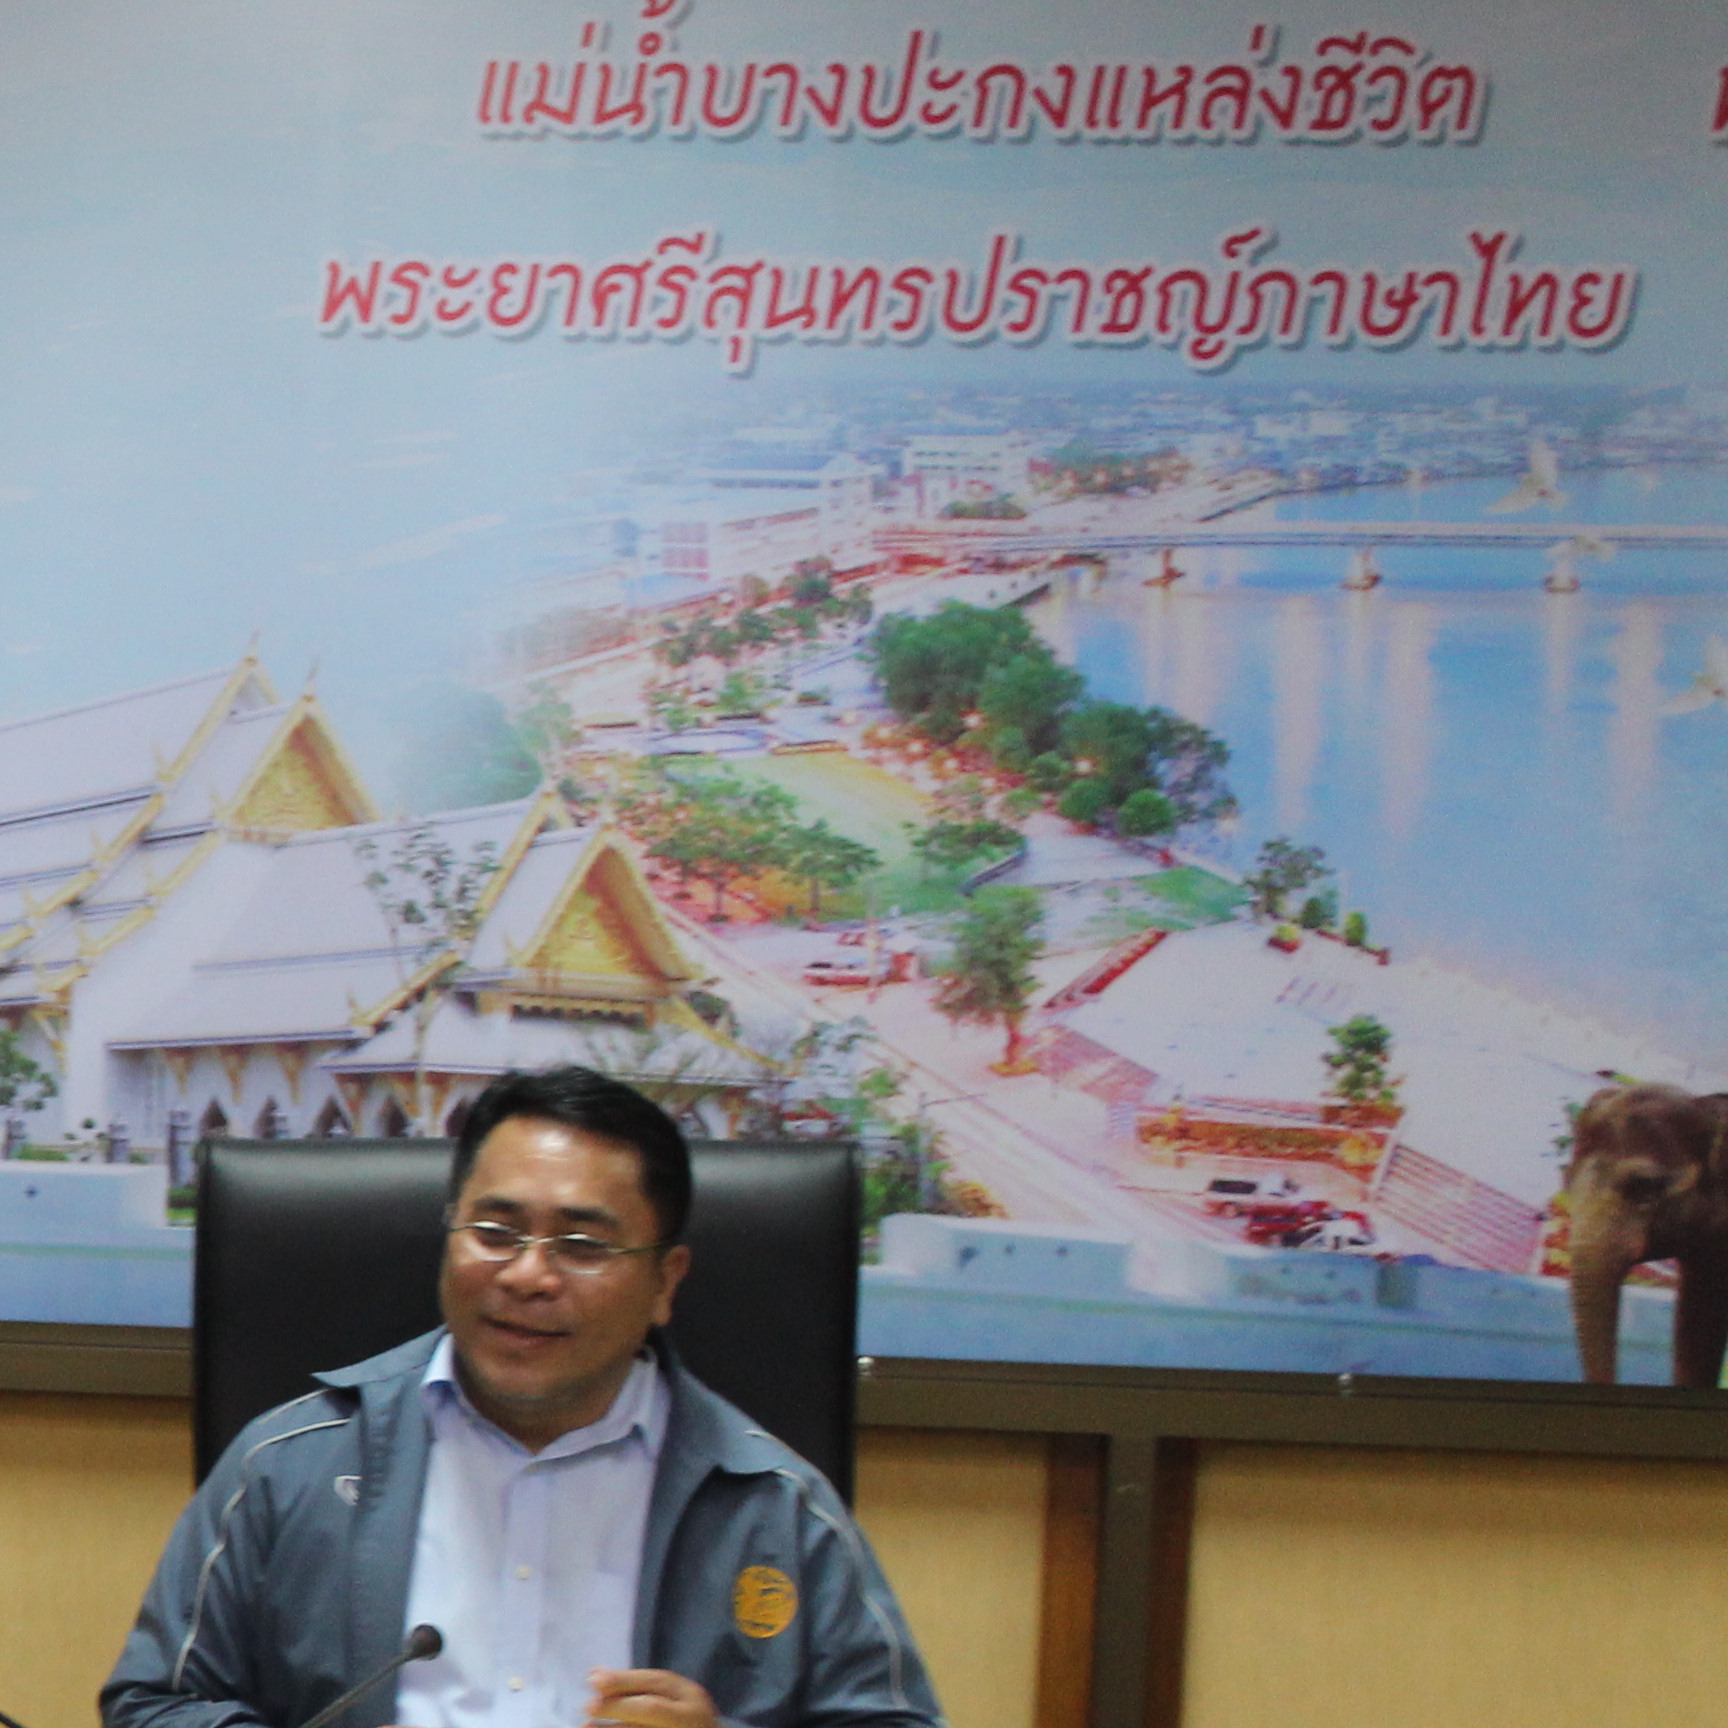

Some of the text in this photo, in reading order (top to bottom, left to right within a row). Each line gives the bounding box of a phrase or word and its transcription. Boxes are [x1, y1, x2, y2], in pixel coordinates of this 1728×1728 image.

[478, 0, 1477, 132] แม่น้ำบางปะกงแหล่งชีวิต
[320, 227, 1626, 363] พระยาศรีสุนทรปราชญ์ภาษาไทย
